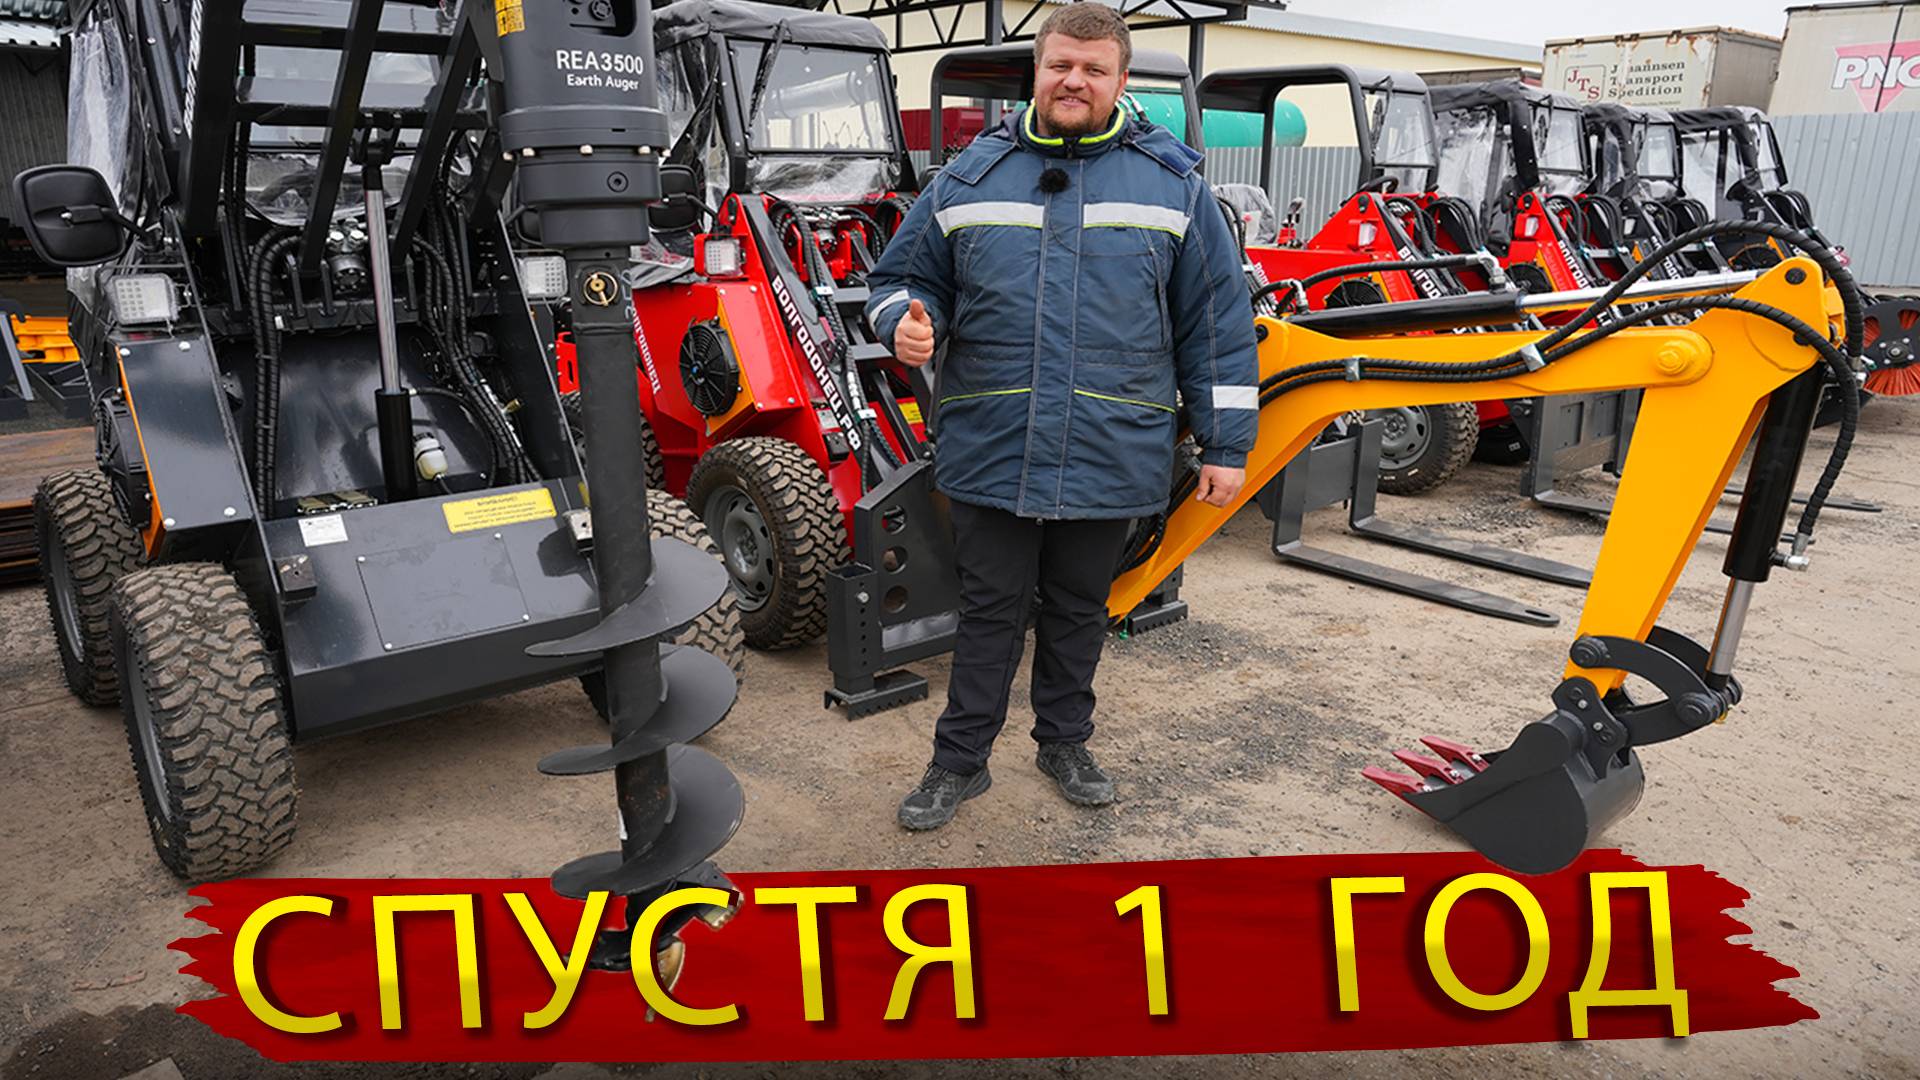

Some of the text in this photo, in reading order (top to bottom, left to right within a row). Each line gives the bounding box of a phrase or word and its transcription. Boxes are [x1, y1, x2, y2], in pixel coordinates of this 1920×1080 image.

[556, 50, 644, 75] REA3500
[1611, 61, 1686, 74] Jannsen
[567, 74, 640, 92] Earth Auger
[1610, 73, 1684, 86] Tansport
